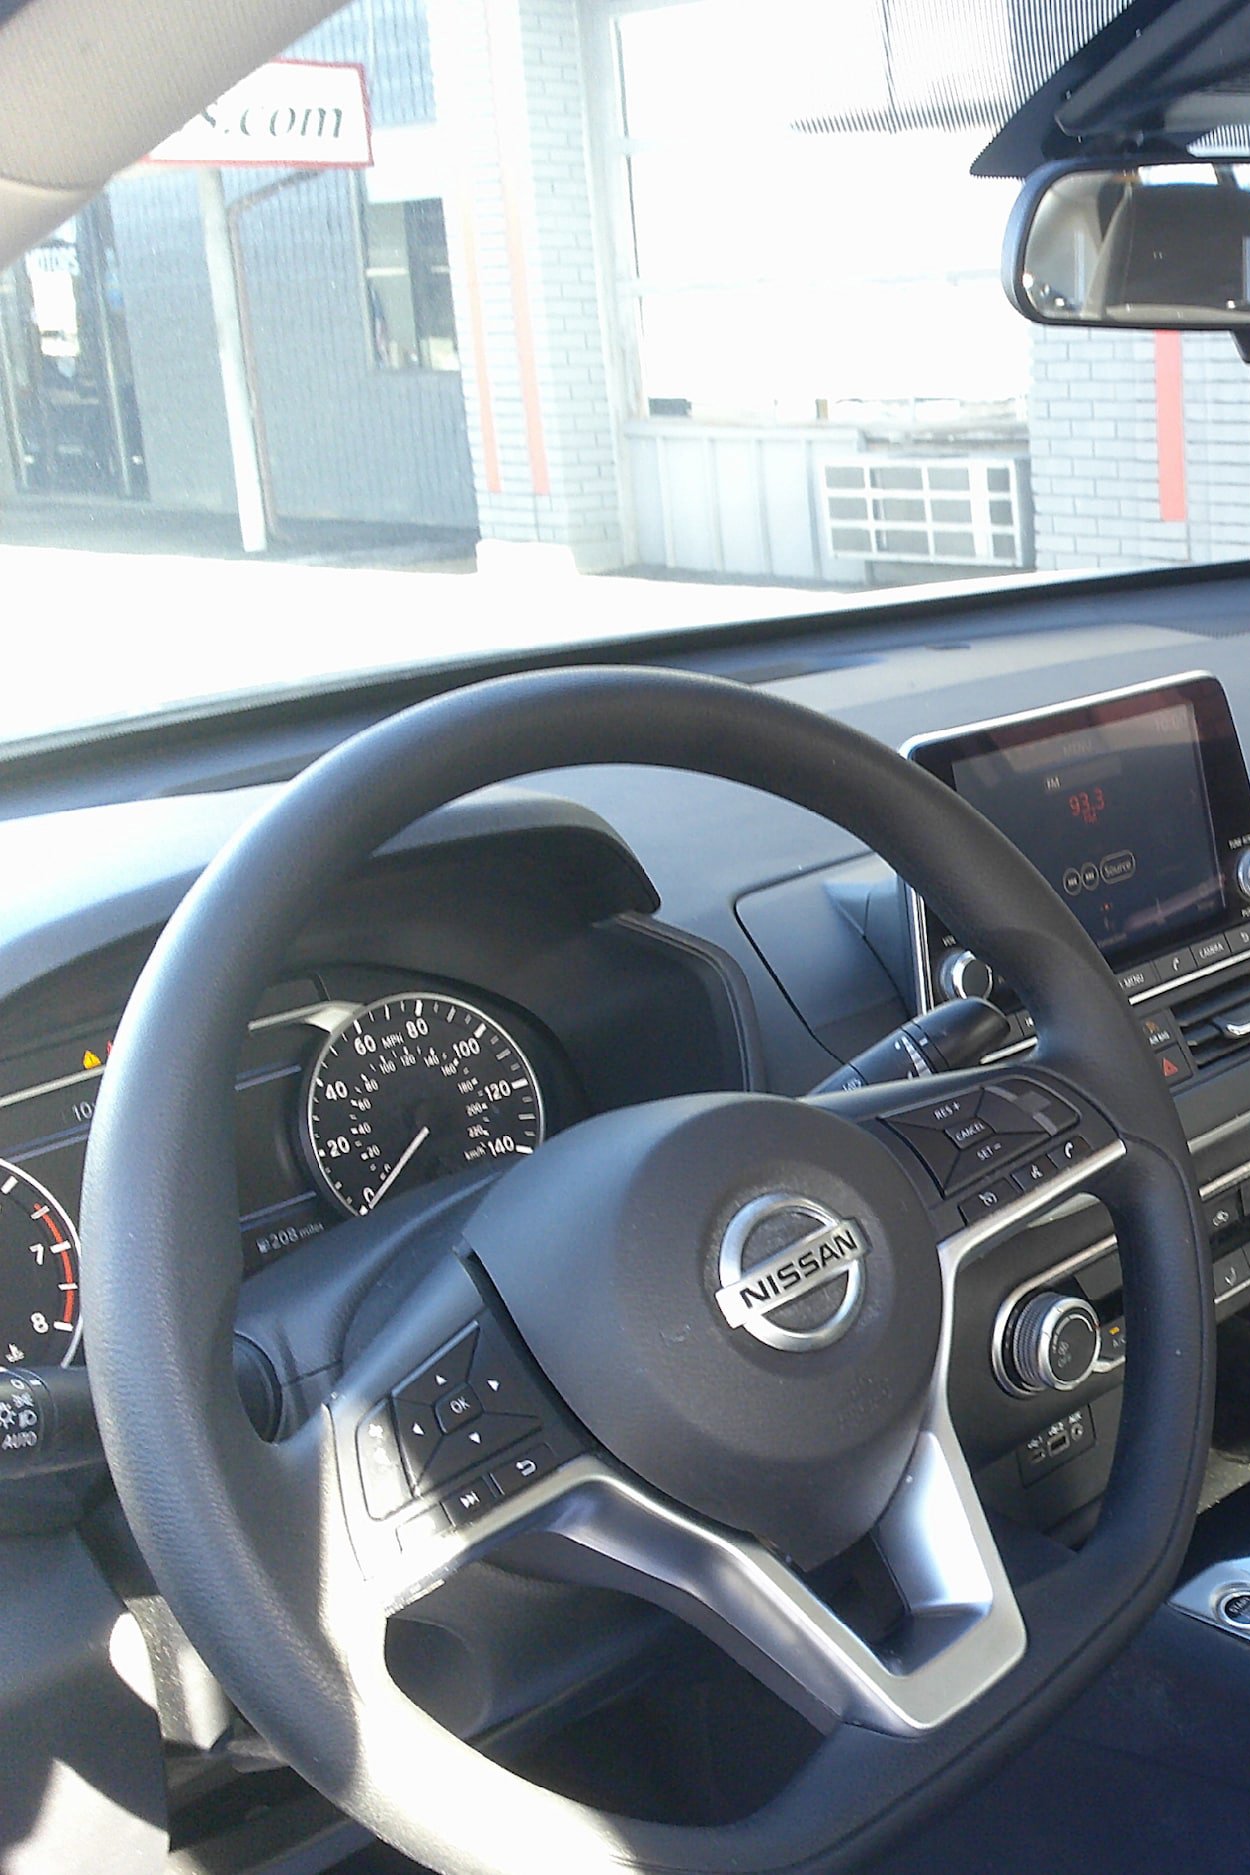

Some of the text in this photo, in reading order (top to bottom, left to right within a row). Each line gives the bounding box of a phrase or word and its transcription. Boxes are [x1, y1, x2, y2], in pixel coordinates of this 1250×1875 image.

[1068, 787, 1105, 816] 93.3
[1104, 860, 1132, 880] Source
[406, 1018, 428, 1039] 80
[354, 1034, 376, 1055] 60
[382, 1032, 404, 1050] MPH
[453, 1038, 480, 1059] 100
[380, 1060, 396, 1075] 100
[326, 1081, 348, 1101] 40
[484, 1080, 511, 1102] 120
[72, 1101, 96, 1122] 10
[327, 1136, 350, 1158] 20
[488, 1135, 514, 1157] 140
[269, 1226, 298, 1250] 208
[30, 1243, 44, 1267] 7
[739, 1230, 858, 1309] NISSAN
[31, 1312, 49, 1334] 8
[450, 1396, 471, 1415] OK
[2, 1430, 37, 1450] AUTO
